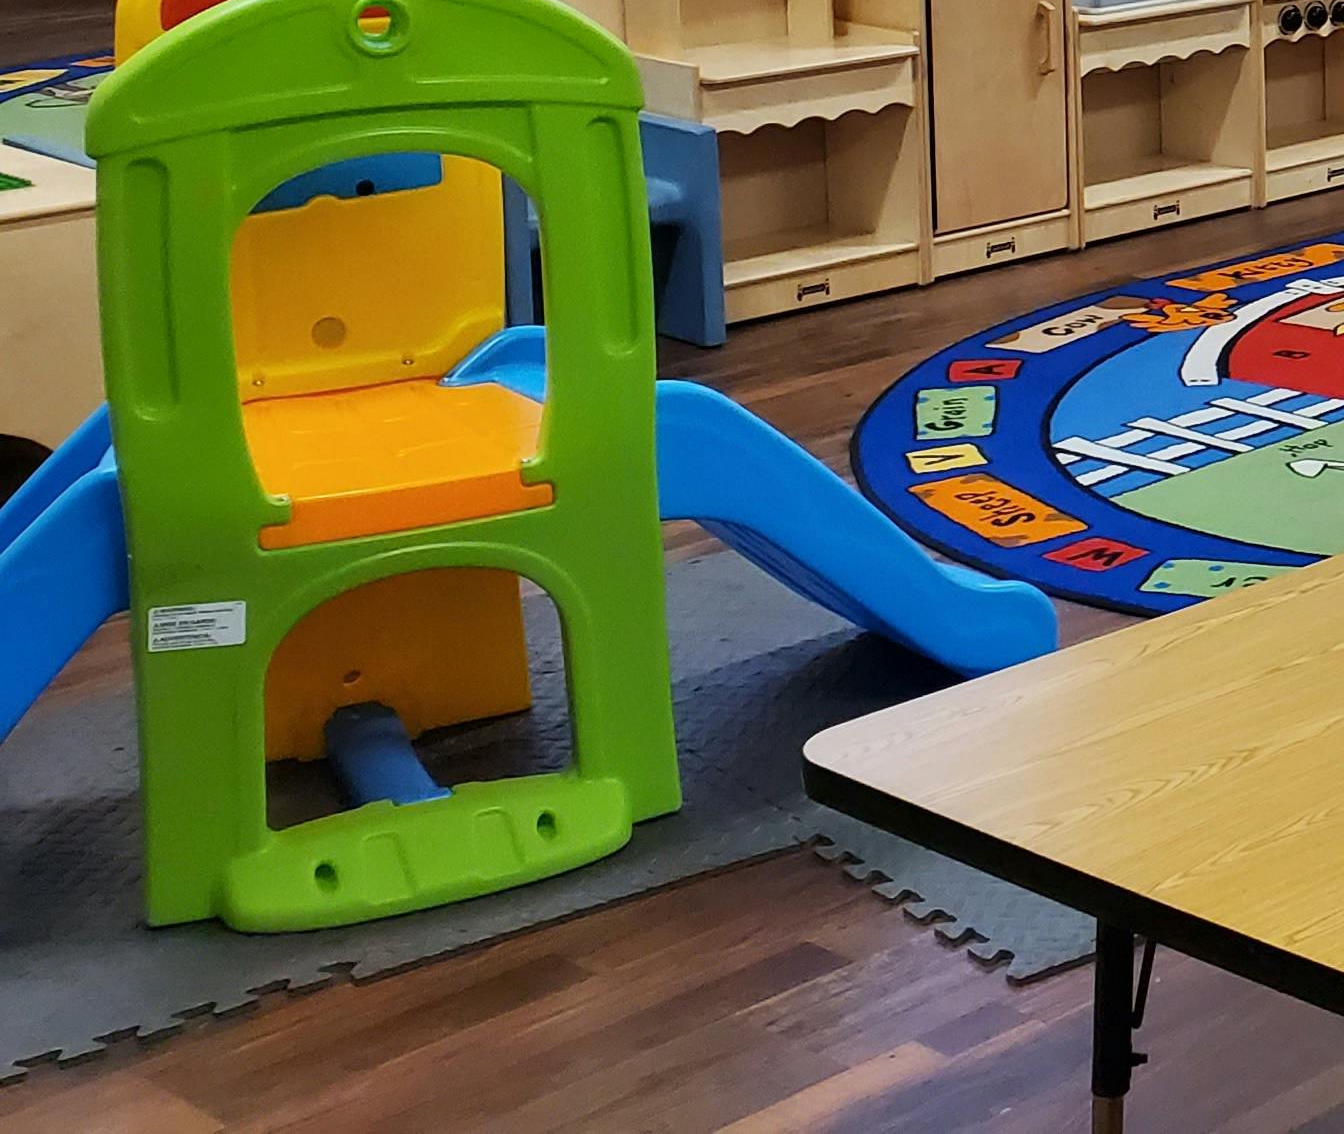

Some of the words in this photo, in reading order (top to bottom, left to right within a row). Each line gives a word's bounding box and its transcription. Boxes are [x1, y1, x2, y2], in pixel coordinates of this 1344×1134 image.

[1218, 253, 1314, 280] Kitty
[1043, 312, 1104, 337] Cow
[962, 364, 1007, 375] A
[924, 397, 969, 432] Grain
[954, 490, 1036, 527] Sheep
